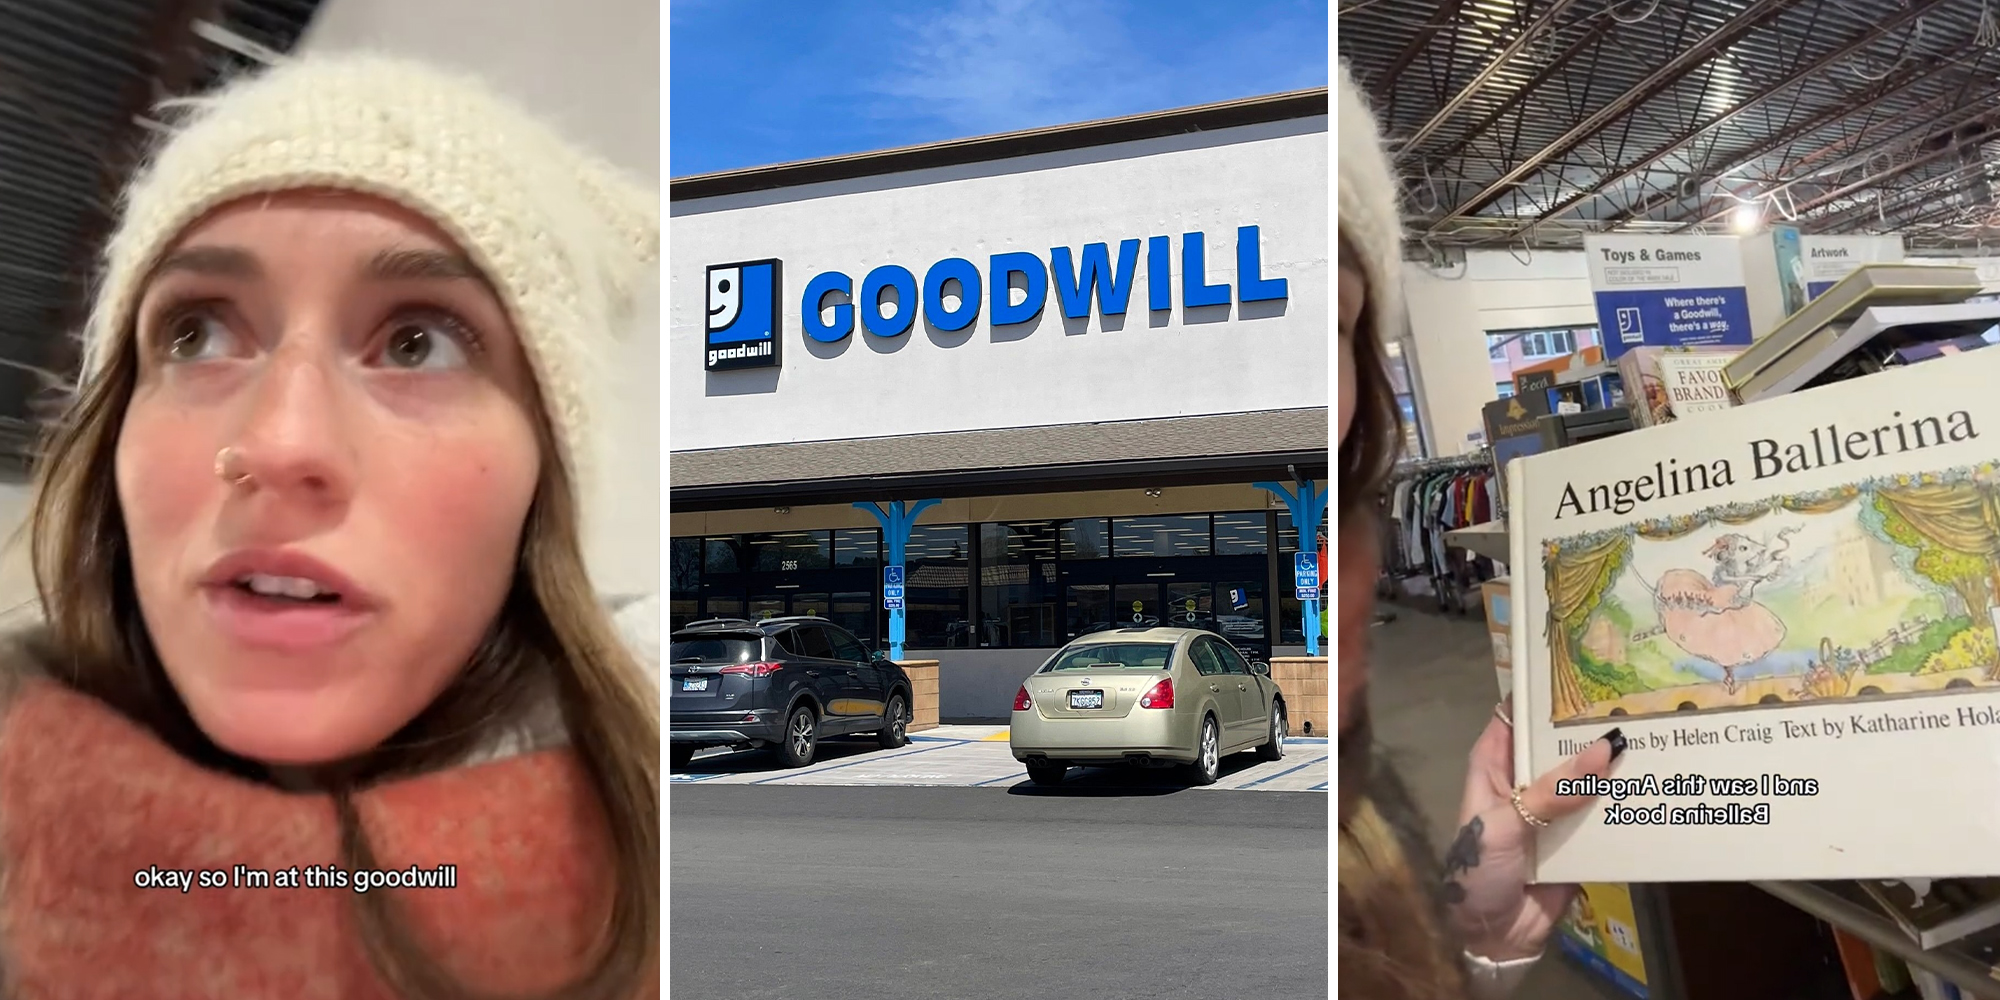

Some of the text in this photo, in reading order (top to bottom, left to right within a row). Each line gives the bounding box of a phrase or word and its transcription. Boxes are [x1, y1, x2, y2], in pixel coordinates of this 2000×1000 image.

[1601, 248, 1702, 263] Toys & Games
[1811, 247, 1848, 258] Artwork
[801, 225, 1288, 343] GOODWILL
[1664, 295, 1726, 307] Where there's
[1674, 307, 1722, 320] a Goodwill,
[1669, 321, 1701, 333] there's
[1702, 322, 1708, 330] a
[708, 341, 772, 367] goodwill
[1678, 370, 1722, 385] FAVO
[1673, 386, 1724, 401] BRAND
[1687, 403, 1724, 413] COOK
[1554, 409, 1979, 520] Angelina Ballerina
[781, 560, 798, 571] 2565
[1301, 578, 1315, 586] ONLY
[1558, 737, 1647, 756] Illusns
[1650, 732, 1669, 751] by
[1673, 729, 1719, 746] Helen
[1724, 723, 1774, 744] Craig
[1780, 720, 1818, 738] Text
[1823, 718, 1845, 738] by
[1850, 711, 1950, 734] Katharine
